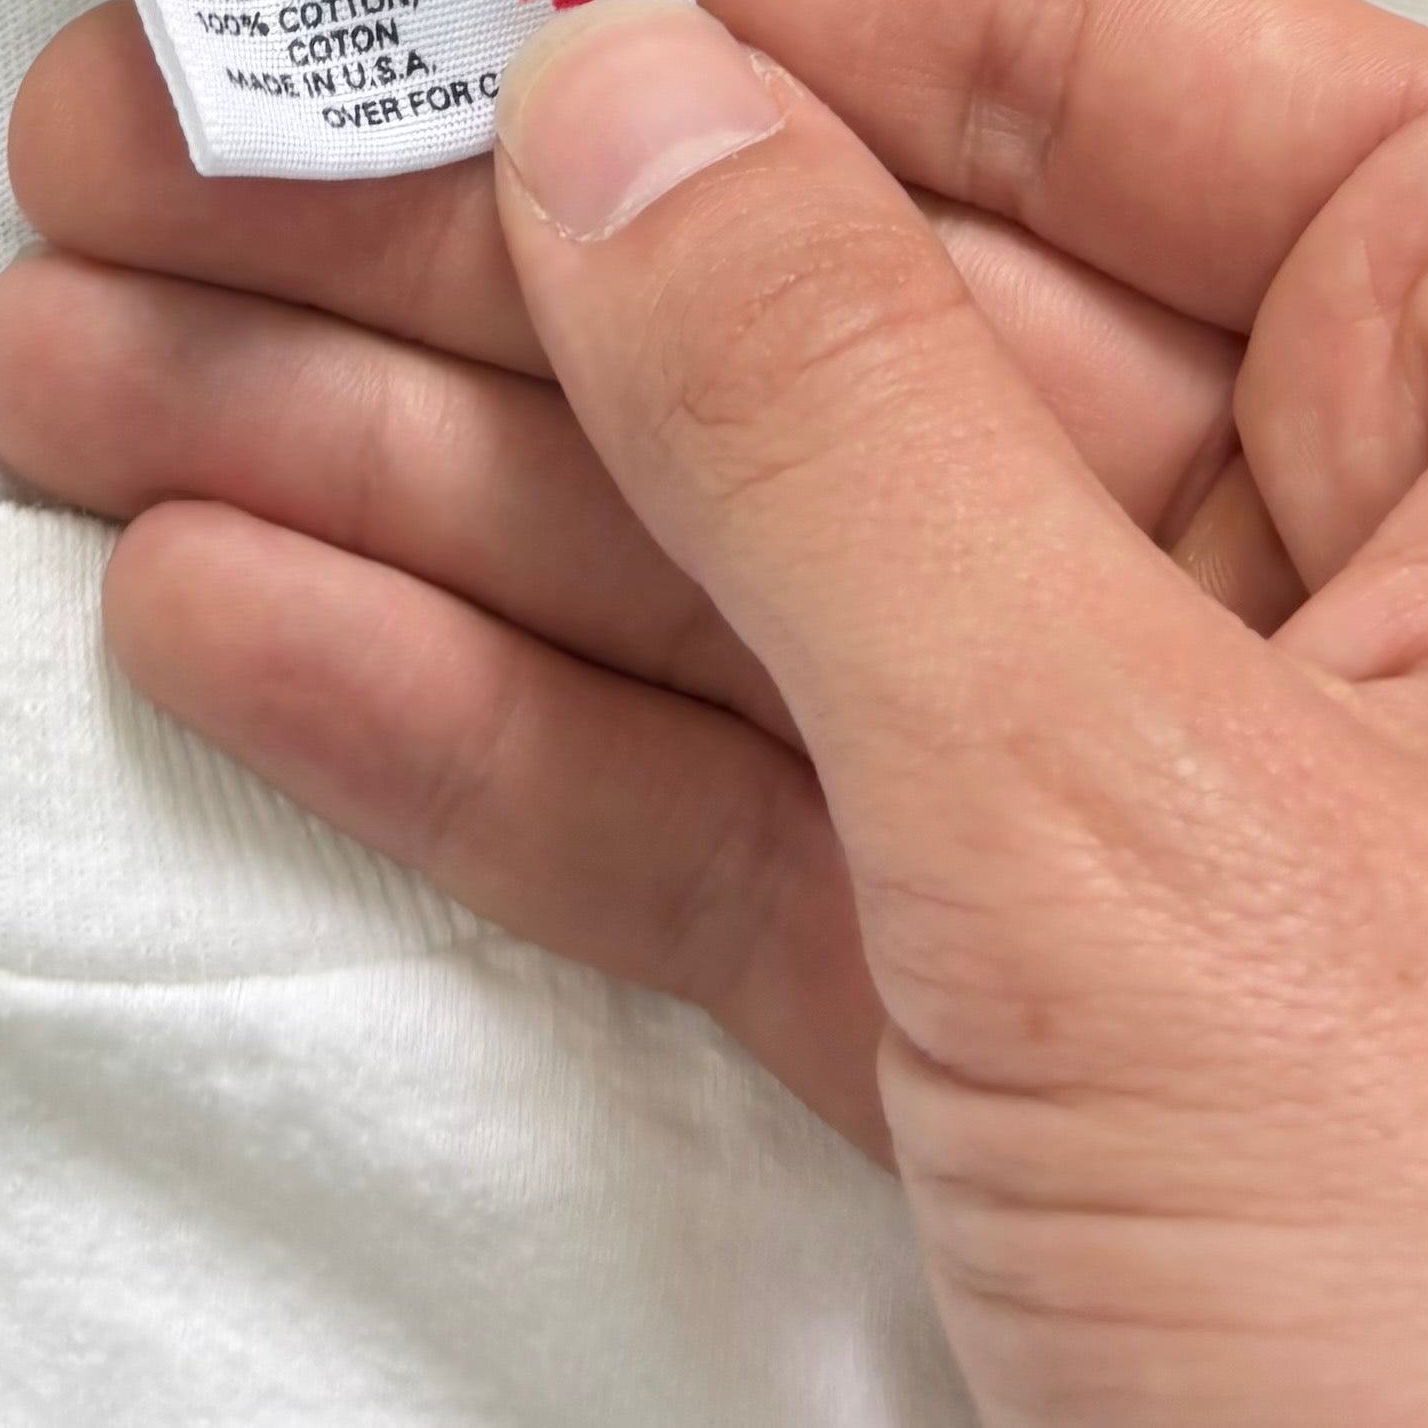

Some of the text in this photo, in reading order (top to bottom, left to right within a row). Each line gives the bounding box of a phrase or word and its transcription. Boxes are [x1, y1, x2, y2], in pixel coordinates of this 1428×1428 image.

[195, 10, 271, 38] 100%
[287, 17, 400, 67] COTON
[226, 66, 301, 98] MADE
[303, 67, 337, 98] IN
[321, 95, 404, 129] OVER
[407, 80, 473, 117] FOR
